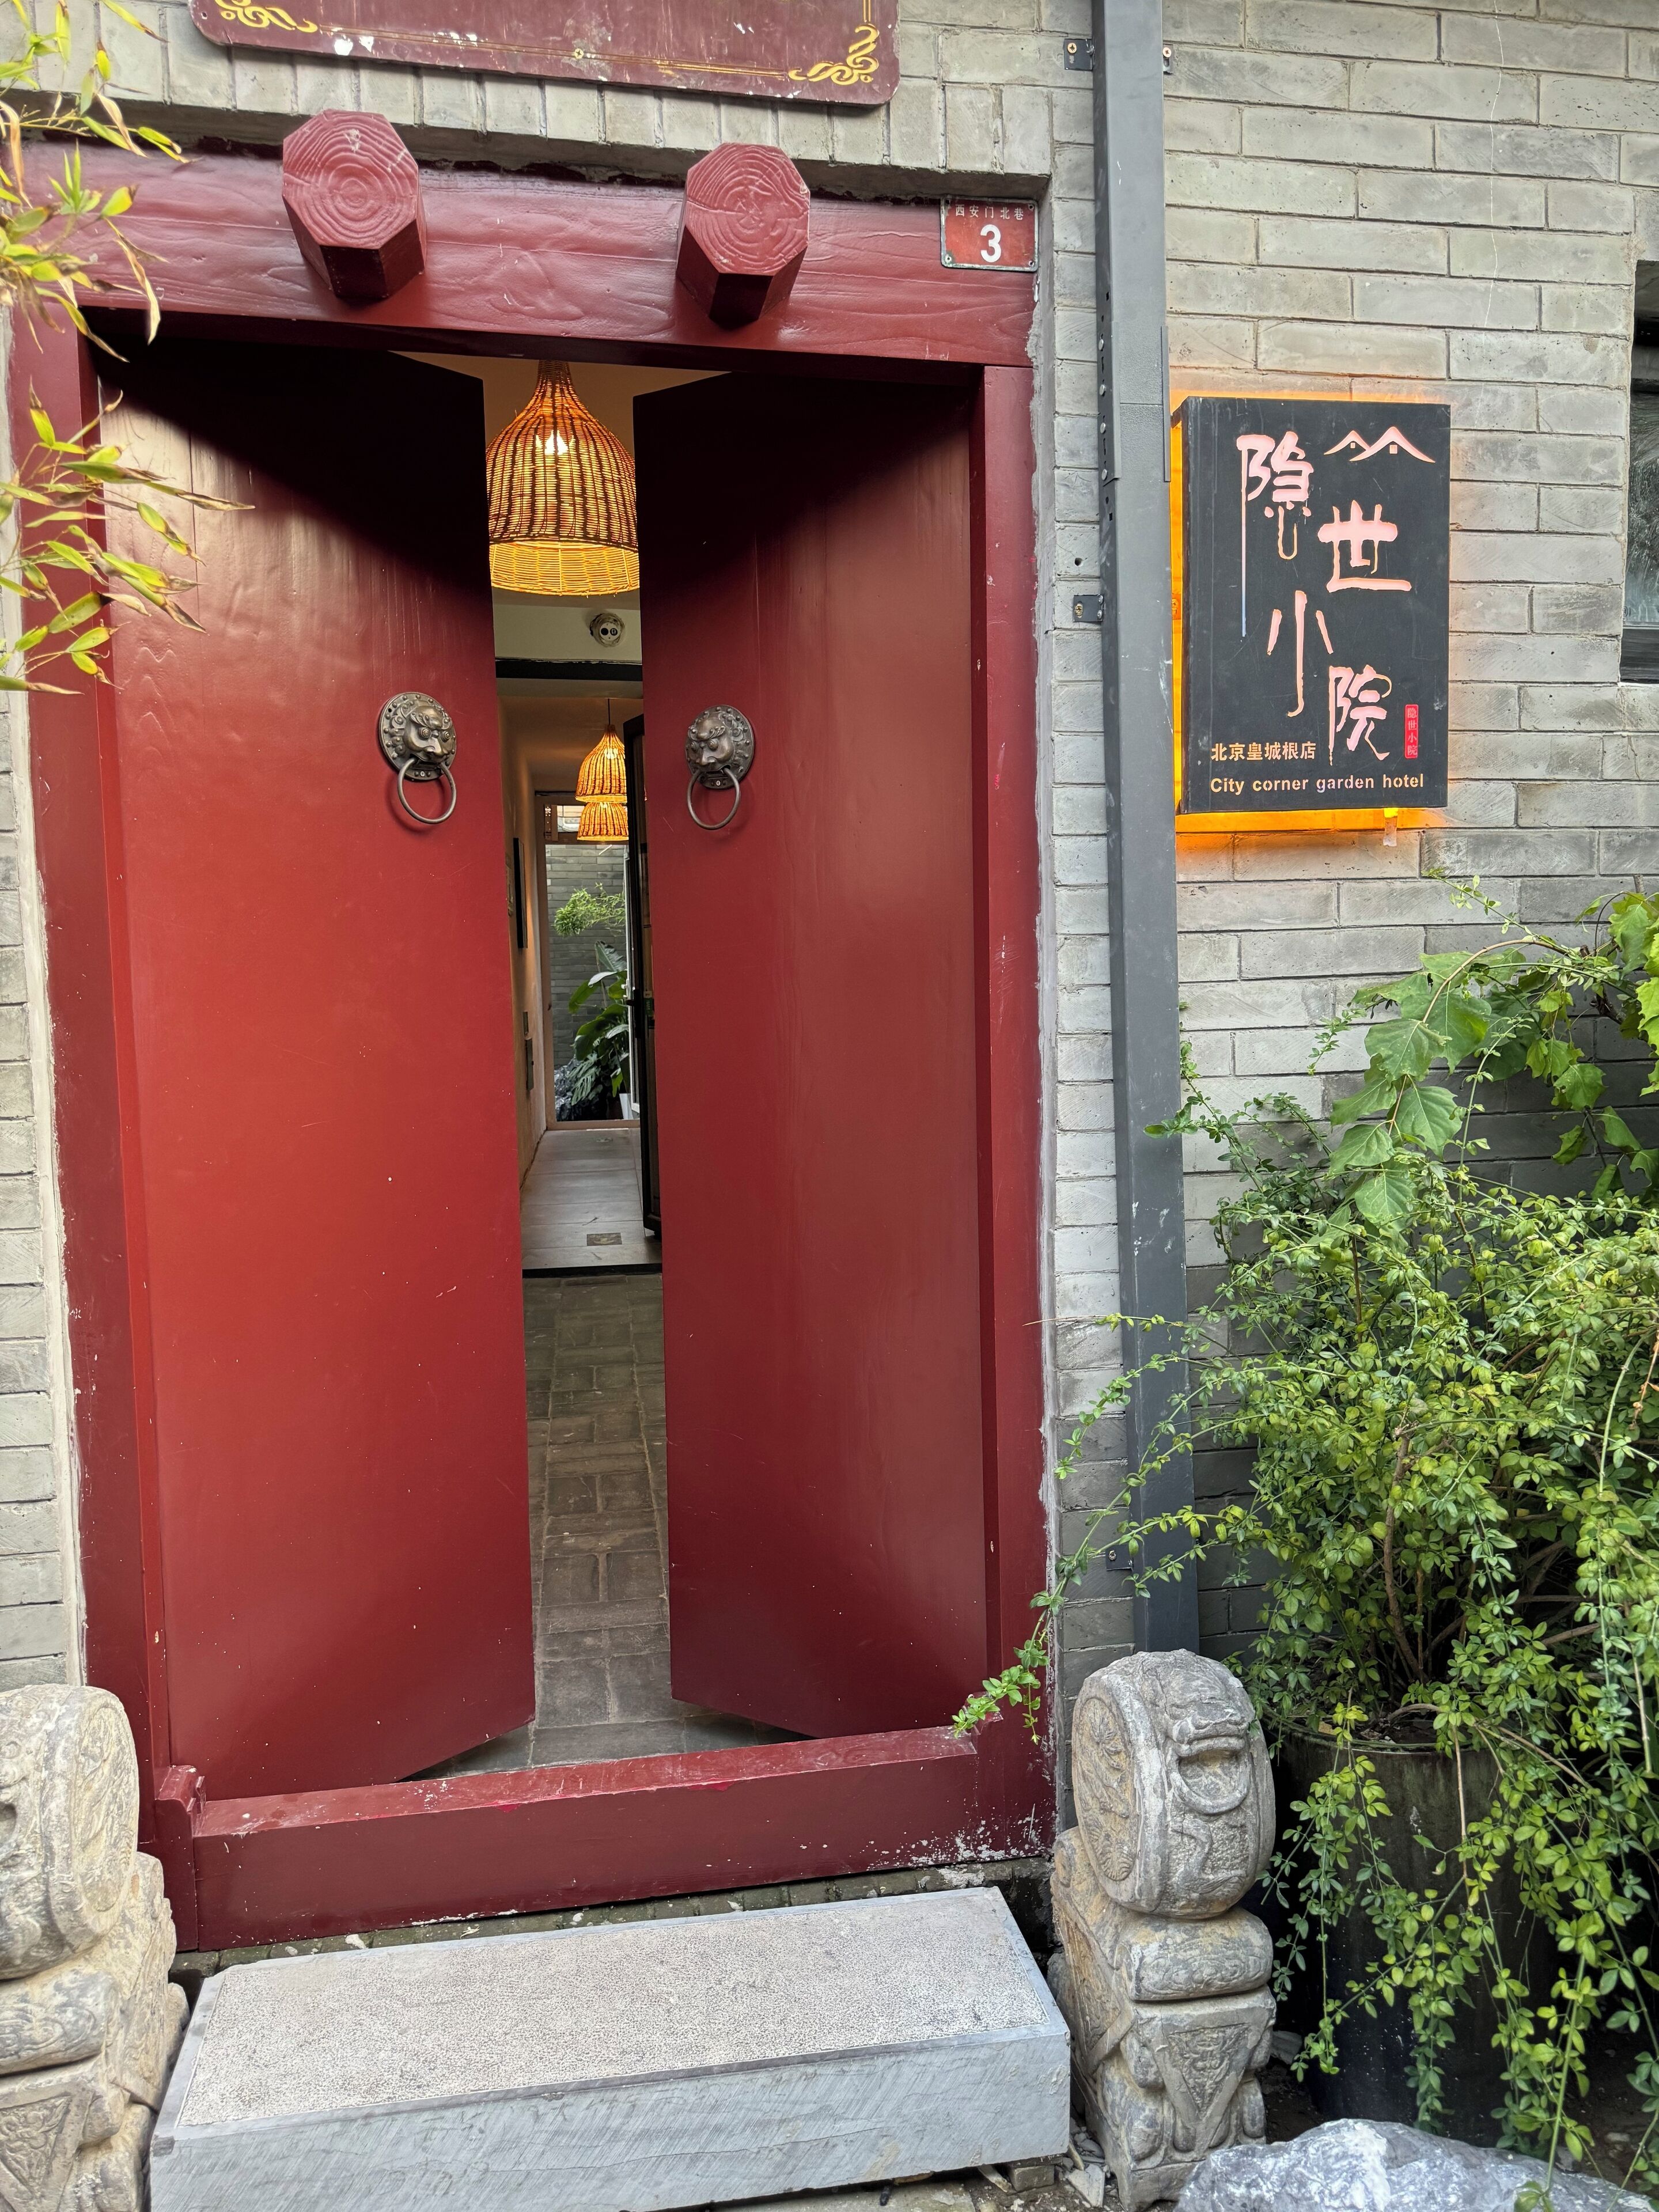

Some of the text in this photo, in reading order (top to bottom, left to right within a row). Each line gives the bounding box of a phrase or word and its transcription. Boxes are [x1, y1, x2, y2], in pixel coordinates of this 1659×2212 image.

[956, 204, 1024, 220] 西安门北巷
[980, 224, 1001, 263] 3
[1407, 707, 1417, 756] 隐世小院
[1211, 741, 1316, 761] 北京皇城根店
[1210, 774, 1424, 795] City corner garden hotel
